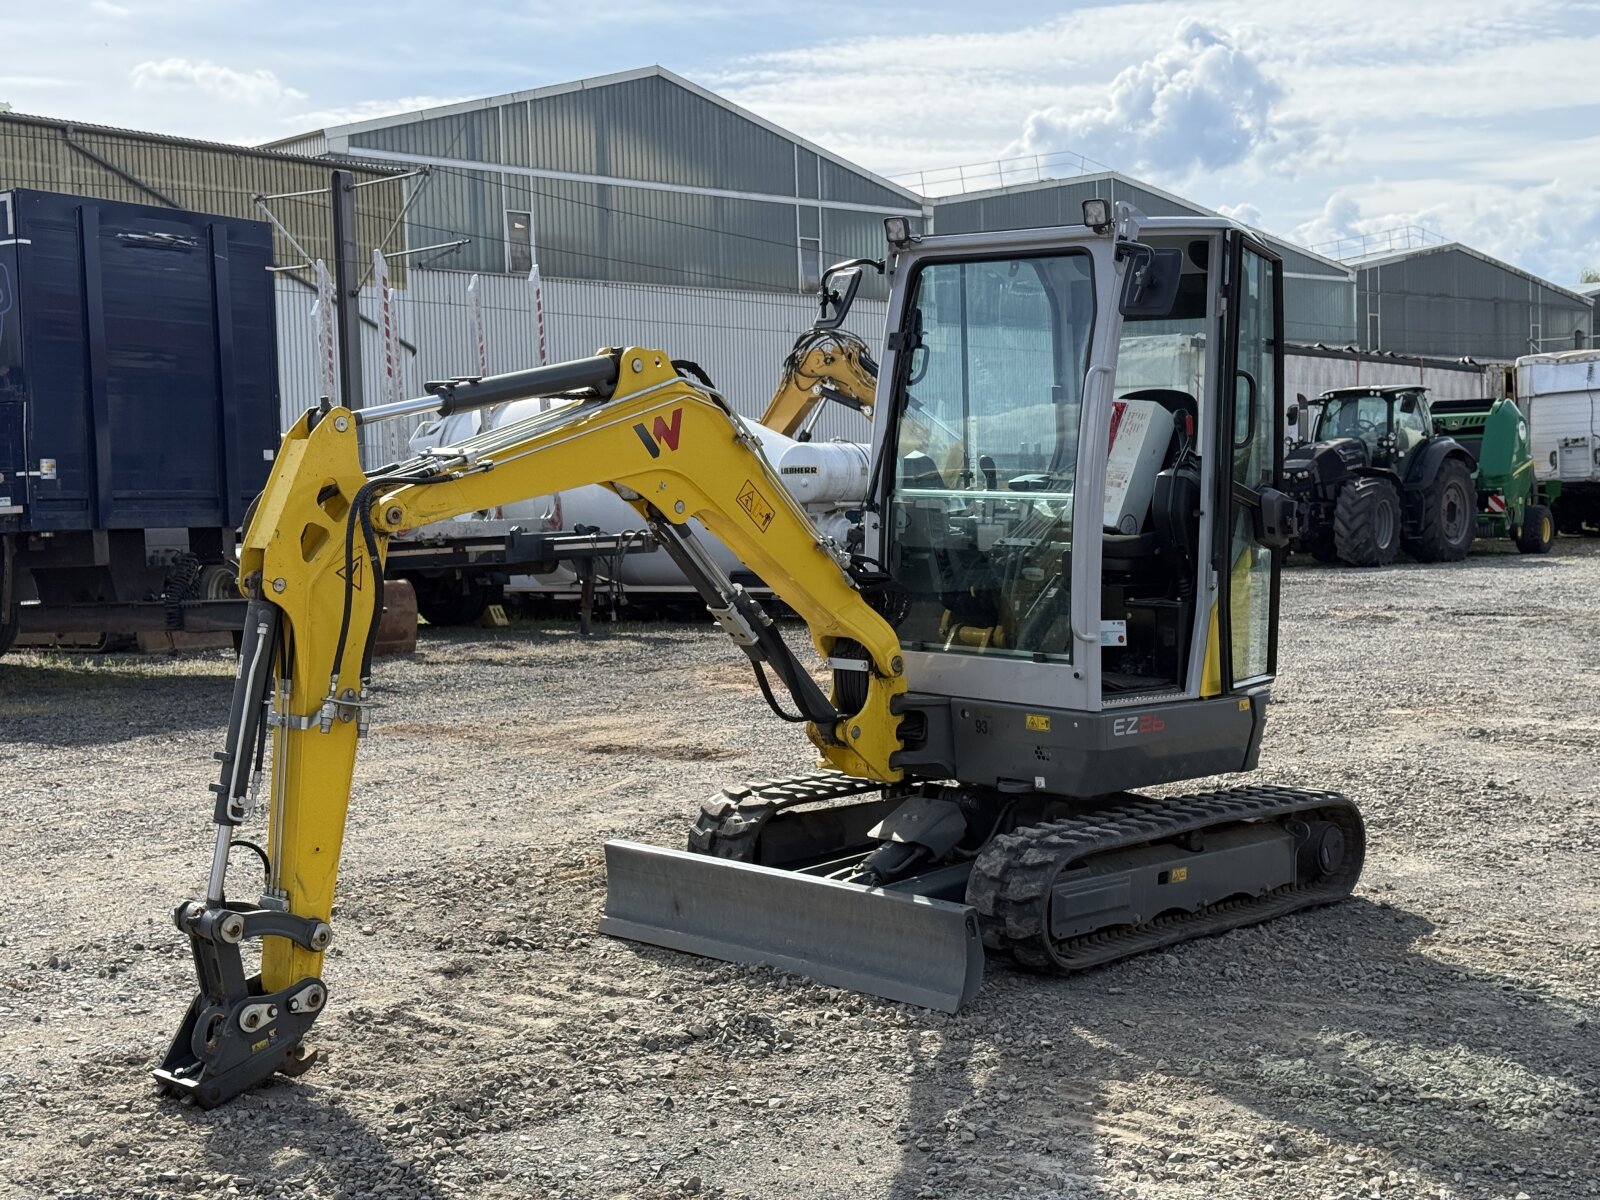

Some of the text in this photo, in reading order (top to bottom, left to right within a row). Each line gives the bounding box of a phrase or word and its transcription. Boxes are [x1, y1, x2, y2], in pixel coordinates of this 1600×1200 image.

[780, 466, 818, 475] LIEBHERR
[975, 719, 988, 735] 93
[1113, 714, 1166, 737] EZ26
